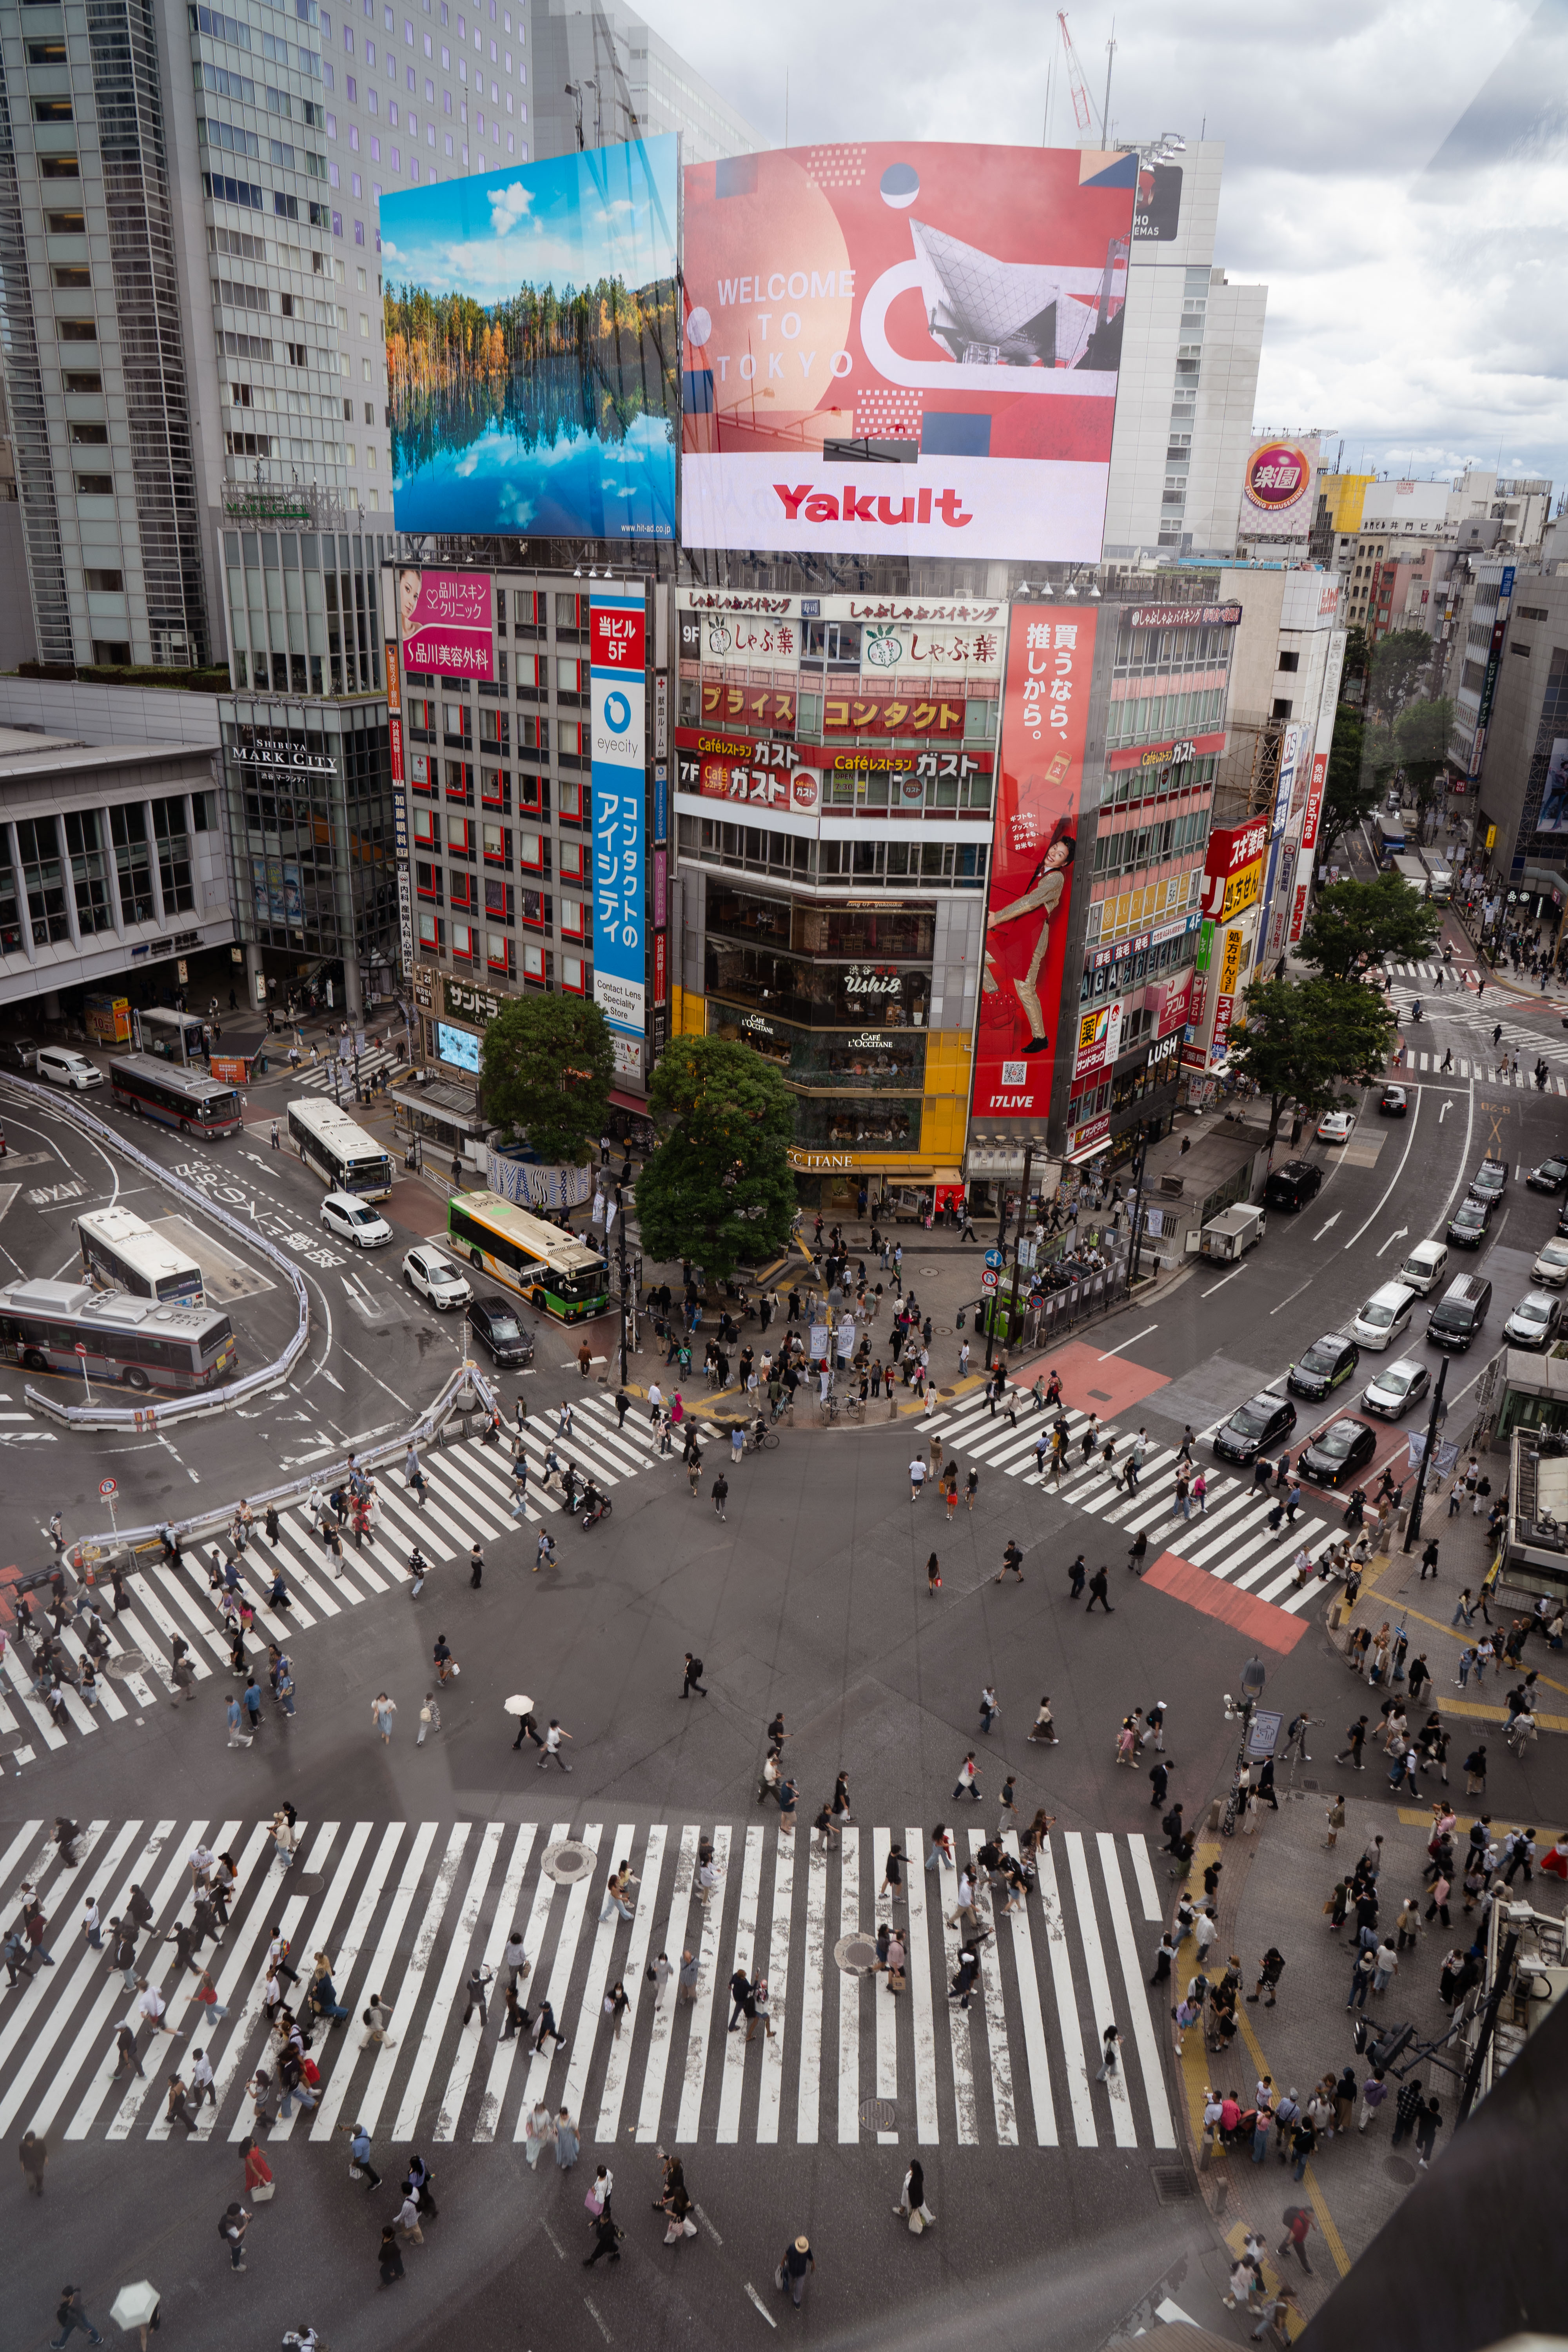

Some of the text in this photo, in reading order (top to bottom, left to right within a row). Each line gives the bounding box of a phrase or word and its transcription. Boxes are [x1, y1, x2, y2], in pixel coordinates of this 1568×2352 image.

[1134, 227, 1159, 236] EMAS
[717, 270, 856, 306] WELCOME
[757, 312, 801, 341] TO
[717, 350, 853, 381] TOKYO
[1253, 465, 1301, 489] 楽園
[772, 484, 973, 528] Yakult
[1245, 485, 1305, 510] EXCITING AMUSEMENT
[621, 524, 671, 535] www.hit-ad.co.jp
[1364, 521, 1385, 530] 井門ビル
[1390, 521, 1443, 531] 井門ビル
[1504, 570, 1513, 579] THE
[438, 581, 486, 600] 品川スキン
[1502, 580, 1511, 595] PRIME
[439, 603, 482, 620] クリニック
[689, 592, 791, 613] しゃぶしゃぶバイキング
[803, 602, 817, 613] 寿司
[850, 601, 999, 622] しゃぶしゃぶバイキング
[1140, 608, 1201, 625] しゃぶしゃぶバイキング
[599, 616, 636, 639] 当ビル
[683, 625, 700, 643] 9F
[735, 624, 793, 655] しゃぶ葉
[911, 633, 997, 663] しゃぶ葉
[415, 644, 488, 671] 品川美容外科
[608, 641, 627, 661] 5F
[1022, 622, 1050, 740] 推しから。
[1049, 624, 1078, 740] 買うなら、
[1322, 637, 1343, 717] BIC CAMERA
[704, 687, 795, 722] プライス
[826, 701, 961, 731] コンタクト
[257, 739, 307, 751] SHIBUYA
[597, 737, 638, 758] eyecity
[754, 741, 799, 769] ガスト
[1172, 741, 1196, 764] ガスト
[1284, 733, 1297, 763] OS
[232, 747, 337, 768] MARK CITY
[835, 753, 978, 777] Caféレストラン ガスト
[261, 772, 306, 784] 渋谷 マークシティ
[681, 762, 700, 782] 7F
[705, 765, 728, 782] Café
[1312, 763, 1324, 784] 免税
[705, 780, 727, 791] レストラン
[730, 767, 785, 803] ガスト
[796, 786, 815, 798] ガスト
[395, 795, 407, 846] 加藤眼科
[1010, 812, 1036, 822] ギフトも、
[1304, 791, 1320, 840] TaxFree
[1012, 822, 1037, 832] グッズも、
[1014, 831, 1039, 841] ガチャも、
[1015, 841, 1036, 850] お米も。
[1230, 826, 1265, 867] スギ薬局
[1283, 844, 1295, 862] OS
[597, 791, 619, 943] アイシティ
[622, 796, 638, 948] コンタクトの
[1280, 863, 1291, 892] 調剤薬局
[400, 886, 409, 902] 内科
[1168, 889, 1176, 902] 5F
[1224, 868, 1258, 914] 処方せん
[1118, 897, 1142, 916] LUCI
[1115, 942, 1130, 960] 抜毛
[1134, 933, 1149, 952] 発毛
[1189, 912, 1202, 930] 4F
[1272, 913, 1284, 949] 処方せん受付
[1226, 931, 1240, 975] 処方せん
[415, 970, 422, 982] 薬
[424, 975, 431, 984] 2F
[849, 965, 897, 975] 渋谷焼肉
[597, 980, 641, 1000] Contact Lens
[844, 976, 901, 993] Ushi8
[1081, 964, 1116, 998] AGA
[1225, 977, 1232, 991] 3F
[416, 985, 431, 998] 処方せん
[420, 996, 429, 1005] 受付
[450, 984, 499, 1018] サンドラ
[603, 993, 635, 1011] Speciality
[1165, 995, 1184, 1018] アコム
[1191, 996, 1200, 1016] アコム
[475, 1015, 490, 1027] CAR
[610, 1007, 628, 1019] Store
[1215, 998, 1231, 1044] スギ薬局
[93, 1017, 114, 1033] 10億円
[1081, 1017, 1095, 1046] 薬
[1170, 1018, 1177, 1029] 3F
[1078, 1049, 1087, 1058] DRUG
[1091, 1041, 1106, 1053] COSMETIC
[1147, 1035, 1178, 1067] LUSH
[1077, 1049, 1105, 1072] サンドラッグ
[990, 1096, 1034, 1107] 17LIVE
[1481, 1102, 1511, 1114] 8-20
[1085, 1116, 1109, 1137] サンドラッグ
[170, 1318, 200, 1327] 1214
